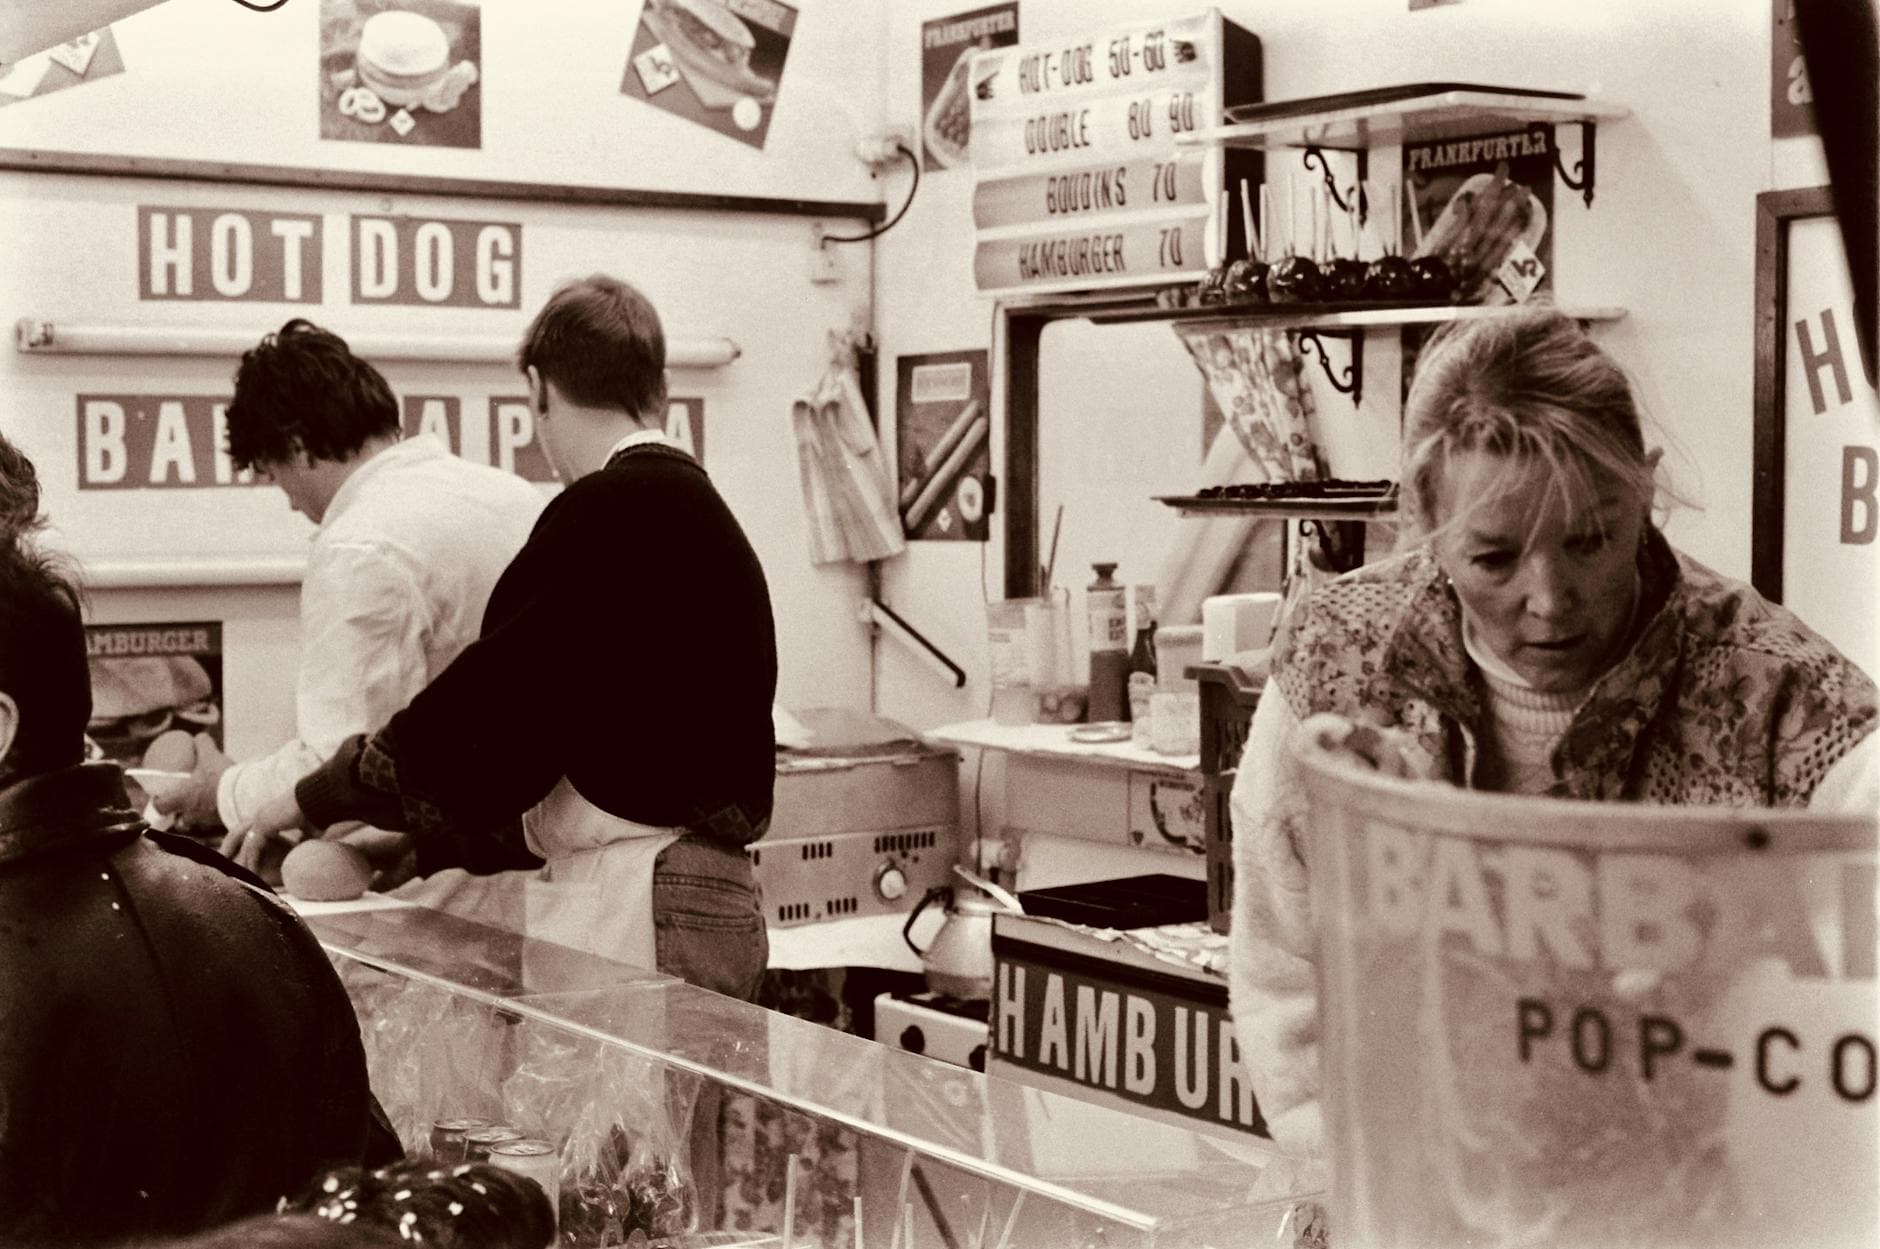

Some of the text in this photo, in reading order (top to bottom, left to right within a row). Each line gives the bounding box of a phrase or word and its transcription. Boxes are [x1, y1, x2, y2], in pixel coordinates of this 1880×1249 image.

[1018, 44, 1092, 95] HOT-DOG
[1025, 92, 1194, 155] DOUBLE 80 90
[1047, 162, 1176, 213] BOUDINS 70
[150, 213, 514, 304] HOT DOG
[1019, 227, 1182, 281] HAMBURGER 70
[1517, 998, 1877, 1102] POP-CO
